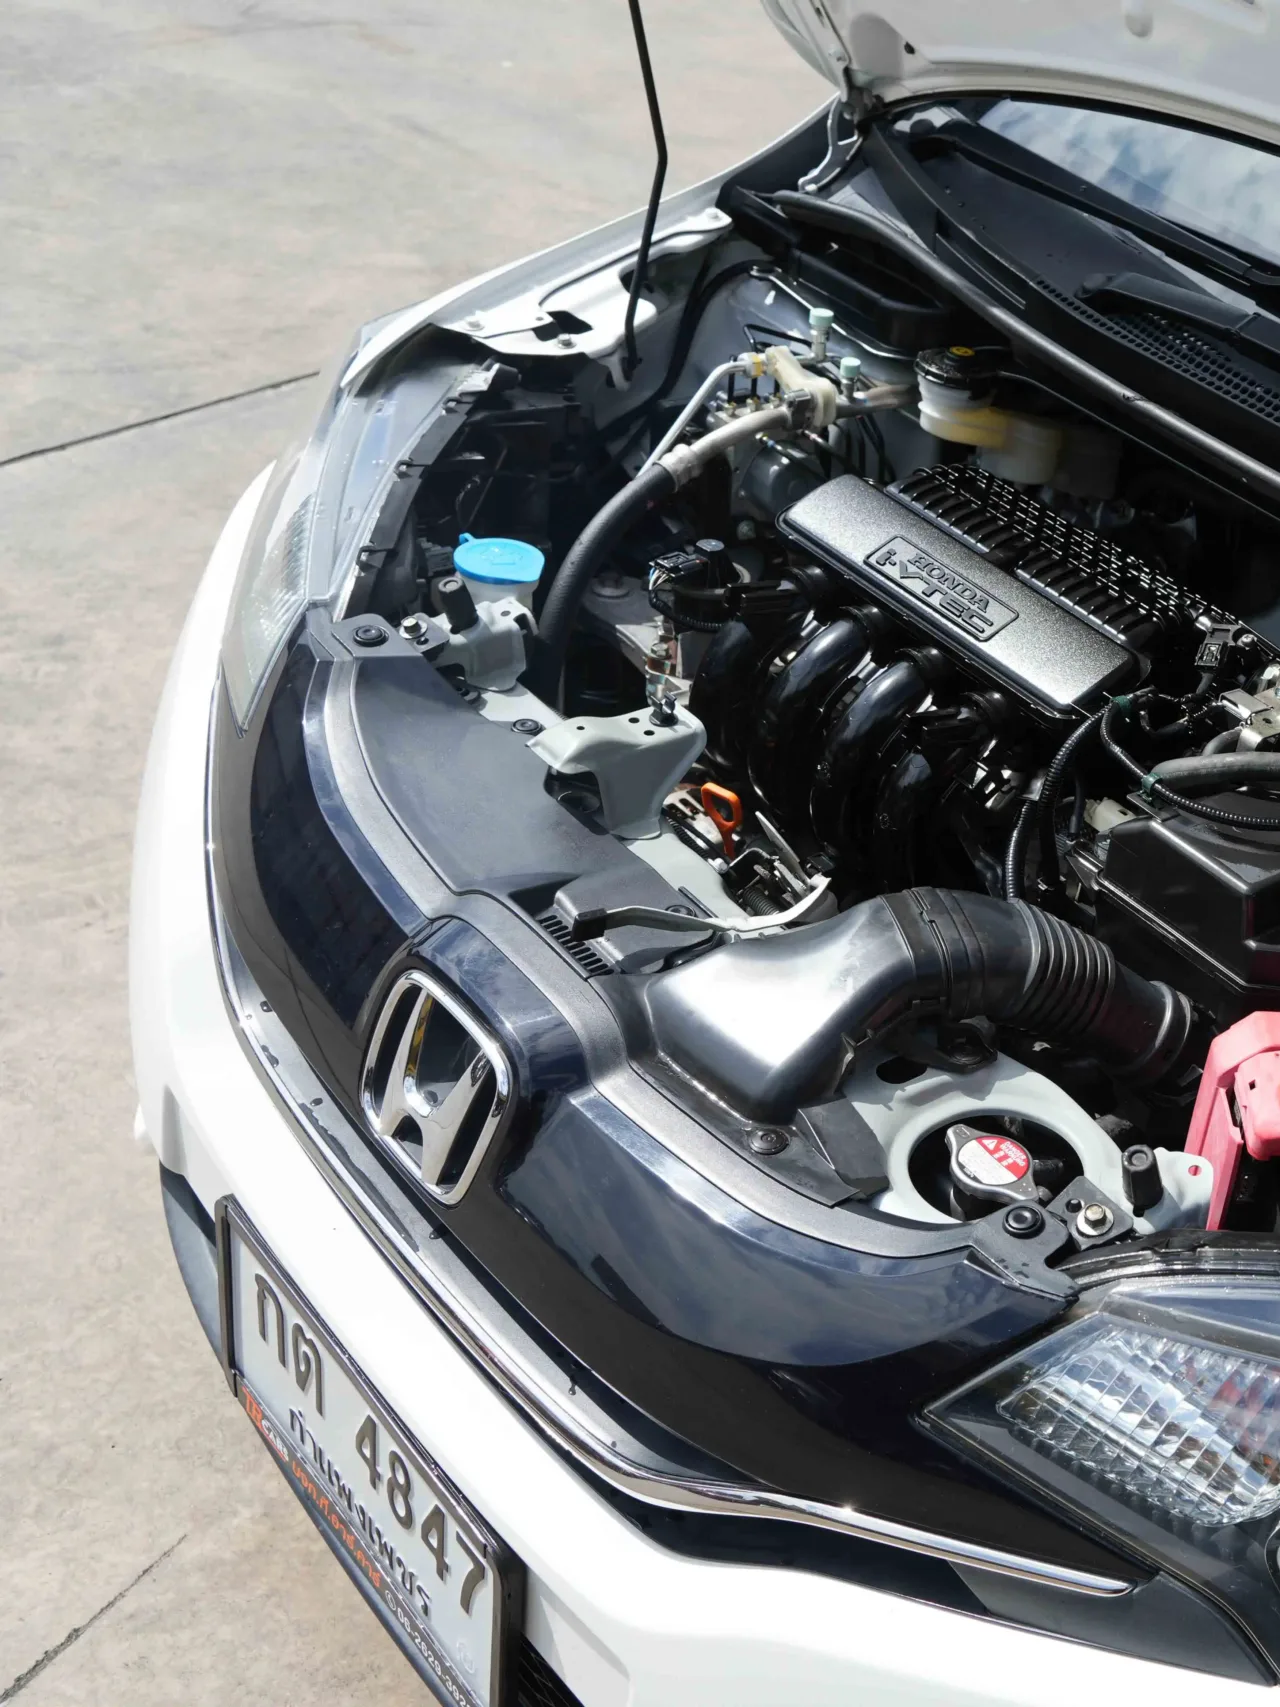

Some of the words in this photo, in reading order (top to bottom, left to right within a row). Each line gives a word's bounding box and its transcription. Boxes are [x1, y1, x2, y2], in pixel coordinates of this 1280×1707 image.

[875, 549, 994, 634] i-VTEC
[907, 552, 990, 613] HONDA
[288, 1405, 432, 1617] กำแพงเพชร
[355, 1413, 486, 1617] 4847
